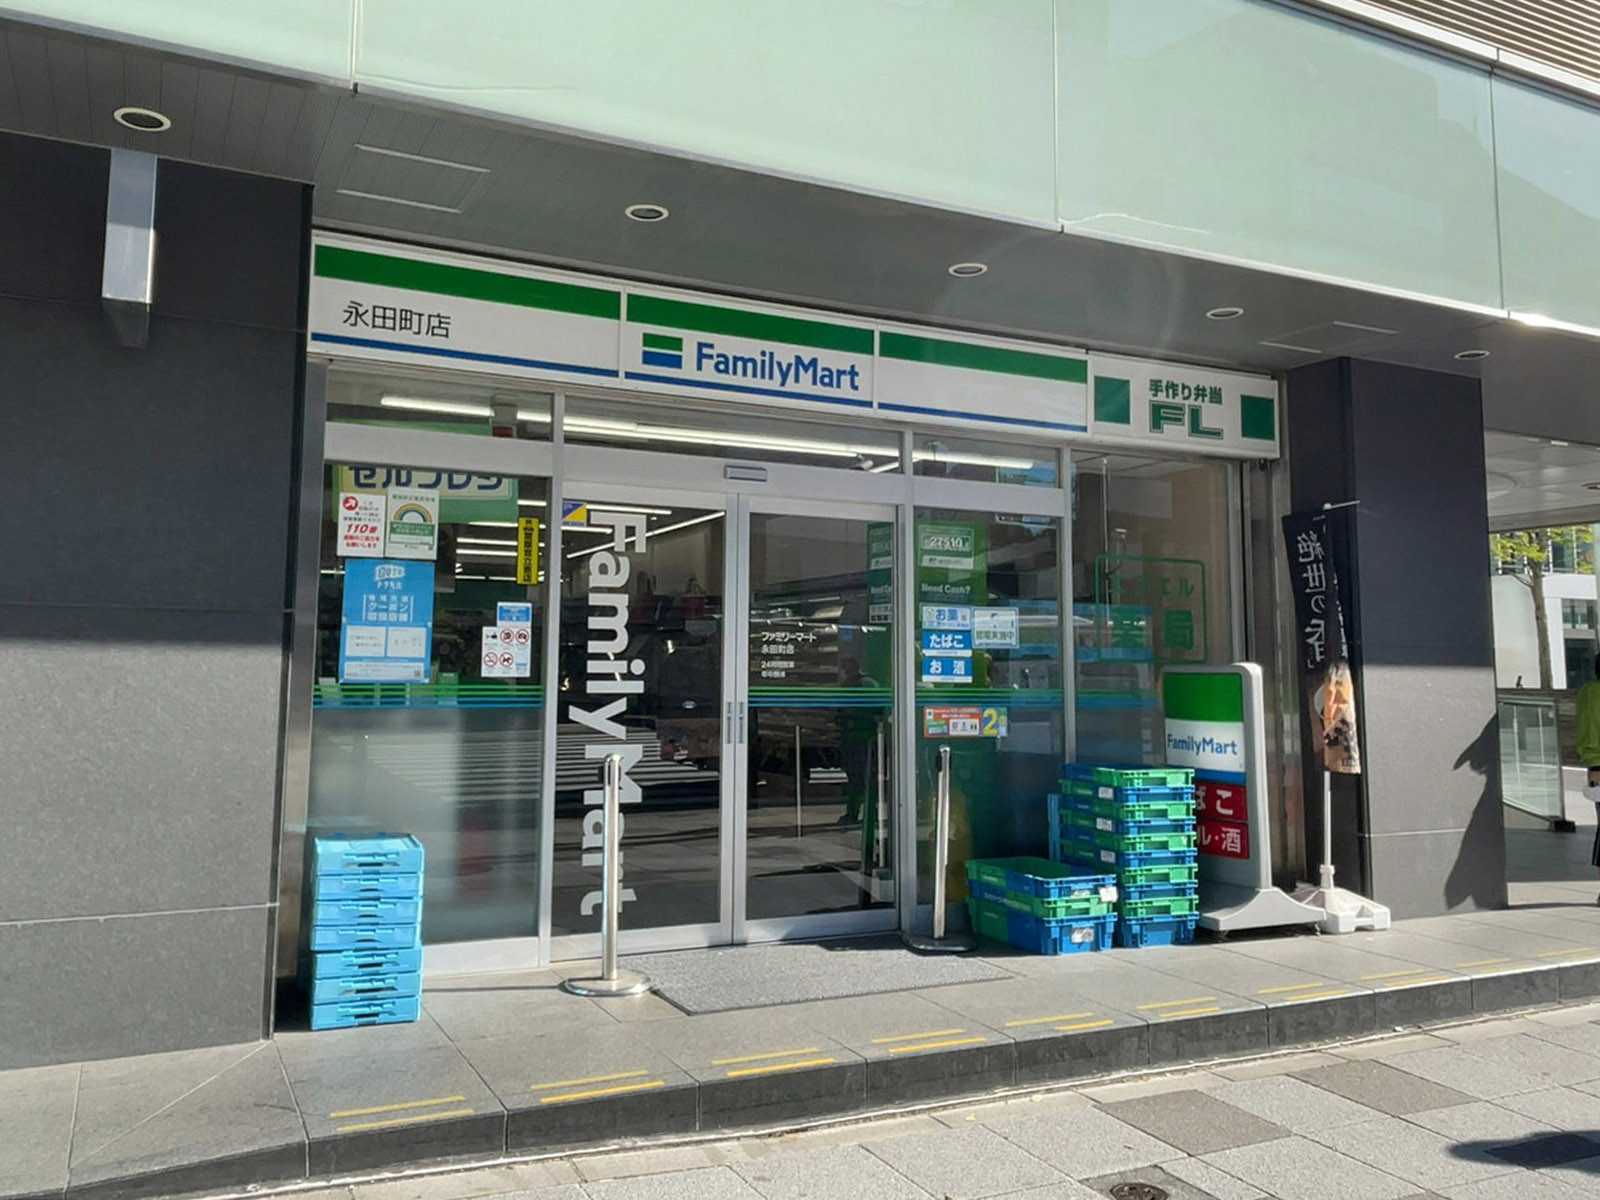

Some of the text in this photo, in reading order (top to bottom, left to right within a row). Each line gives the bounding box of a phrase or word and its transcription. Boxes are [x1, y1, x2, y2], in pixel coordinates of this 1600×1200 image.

[343, 301, 451, 339] 永田町店
[697, 341, 860, 392] FamilyMart
[1149, 379, 1223, 405] 手作り弁当
[1149, 400, 1224, 440] FL
[761, 631, 817, 643] ファミリーマート
[929, 634, 965, 649] たばこ
[761, 643, 795, 655] 永田町店
[929, 659, 966, 675] お酒
[1167, 733, 1238, 756] FamilyMart
